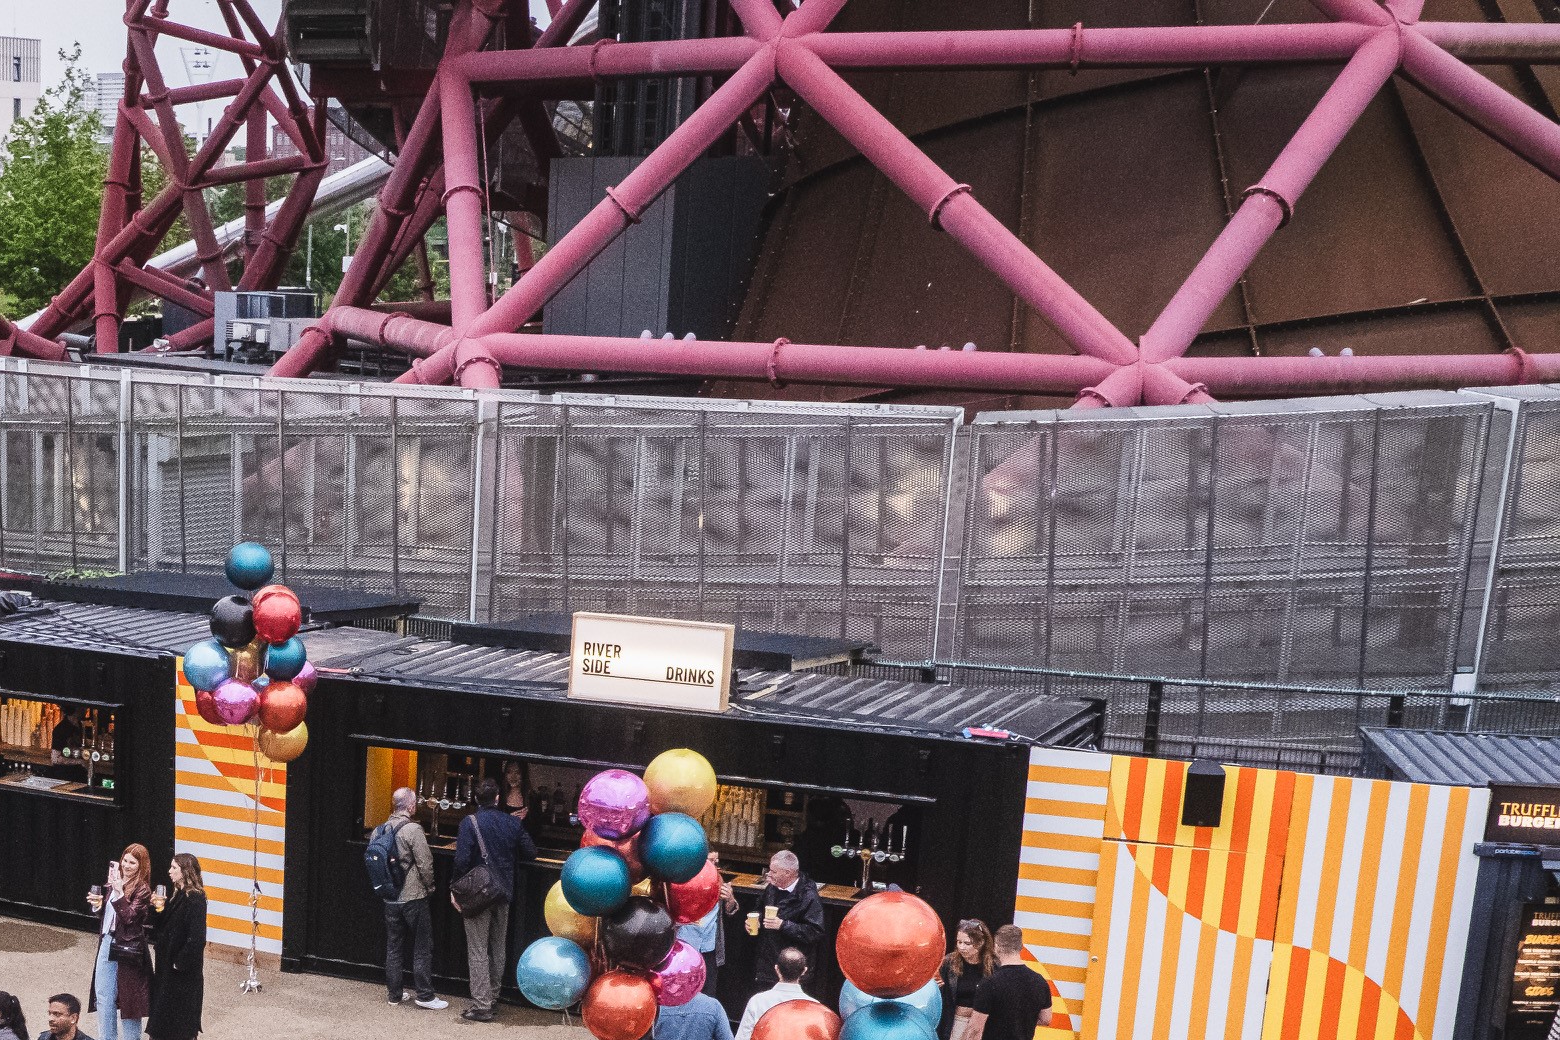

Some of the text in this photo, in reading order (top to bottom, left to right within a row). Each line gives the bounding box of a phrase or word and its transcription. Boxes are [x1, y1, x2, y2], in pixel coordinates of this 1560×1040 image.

[583, 641, 622, 659] RIVER
[582, 658, 715, 685] SIDE DRINKS
[1500, 802, 1560, 818] TRUFFL
